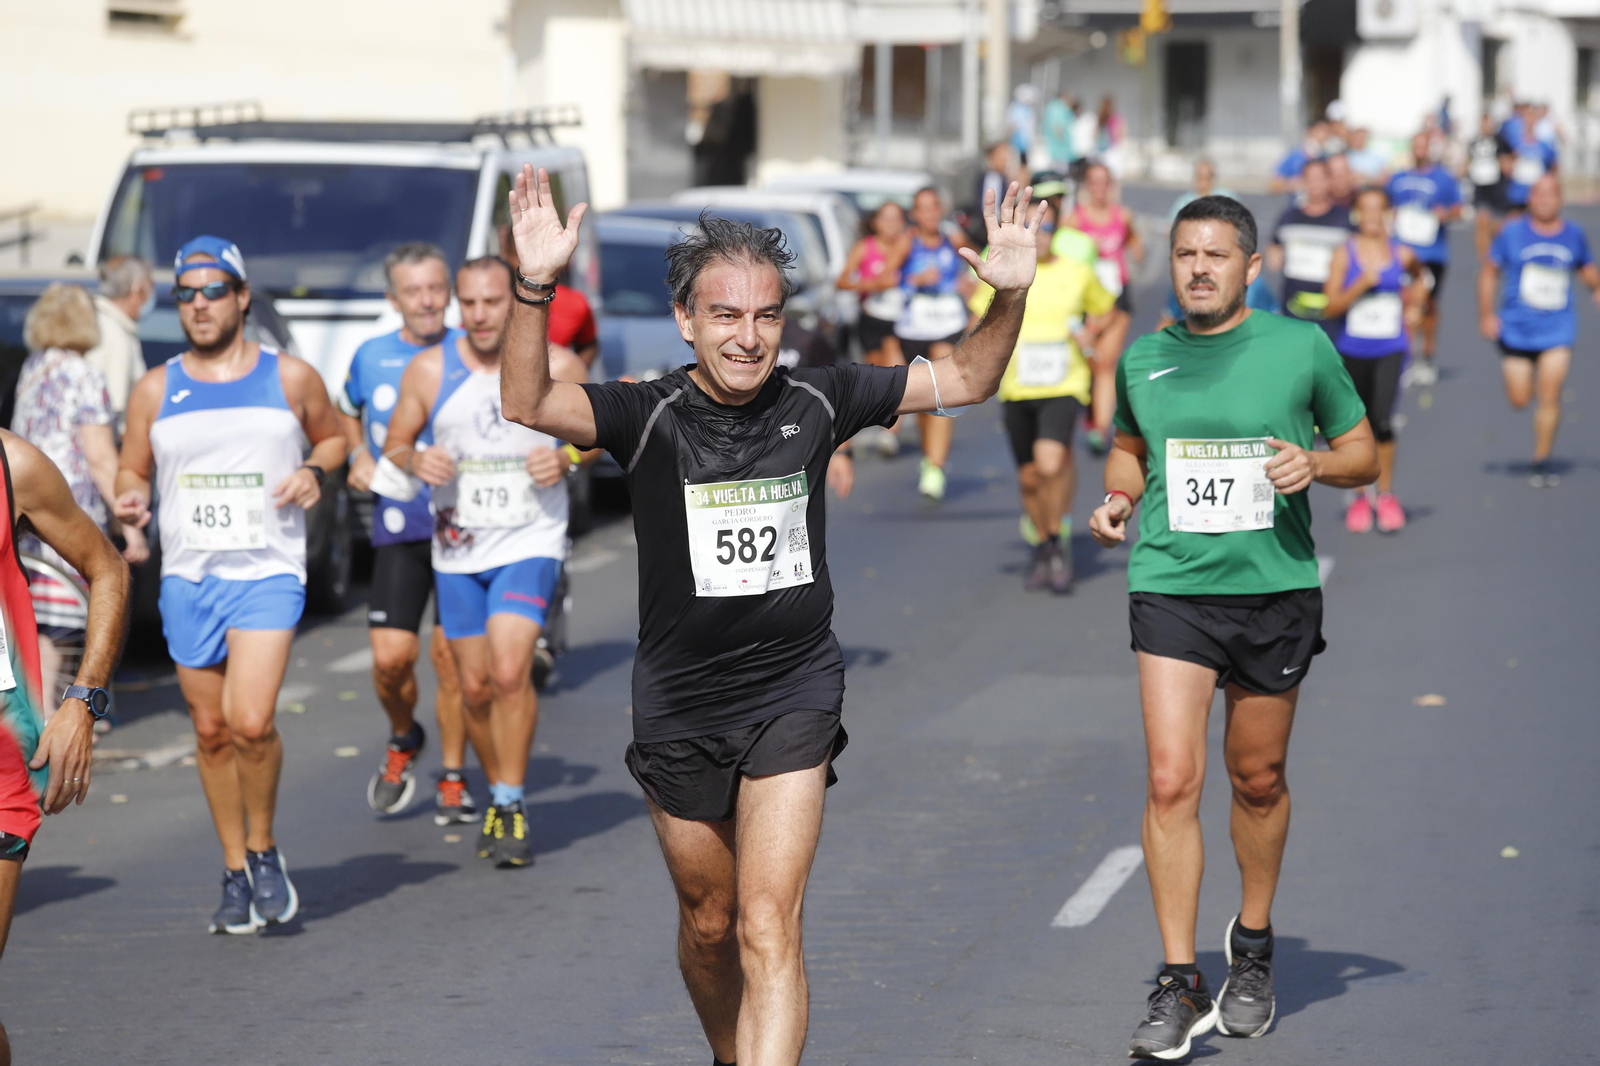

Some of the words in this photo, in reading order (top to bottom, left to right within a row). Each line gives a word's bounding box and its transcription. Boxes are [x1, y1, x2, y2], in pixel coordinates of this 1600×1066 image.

[1185, 444, 1220, 458] VUELTA
[1221, 445, 1228, 457] A
[1230, 443, 1266, 457] HUELVA
[471, 486, 509, 509] 479
[696, 492, 709, 506] 34
[712, 486, 757, 505] VUELTA
[759, 485, 767, 501] A
[770, 480, 802, 500] HUELVA
[1186, 478, 1235, 507] 347
[192, 504, 232, 529] 483
[724, 508, 756, 517] PEDRO
[739, 515, 773, 523] CORDERO
[716, 526, 777, 565] 582
